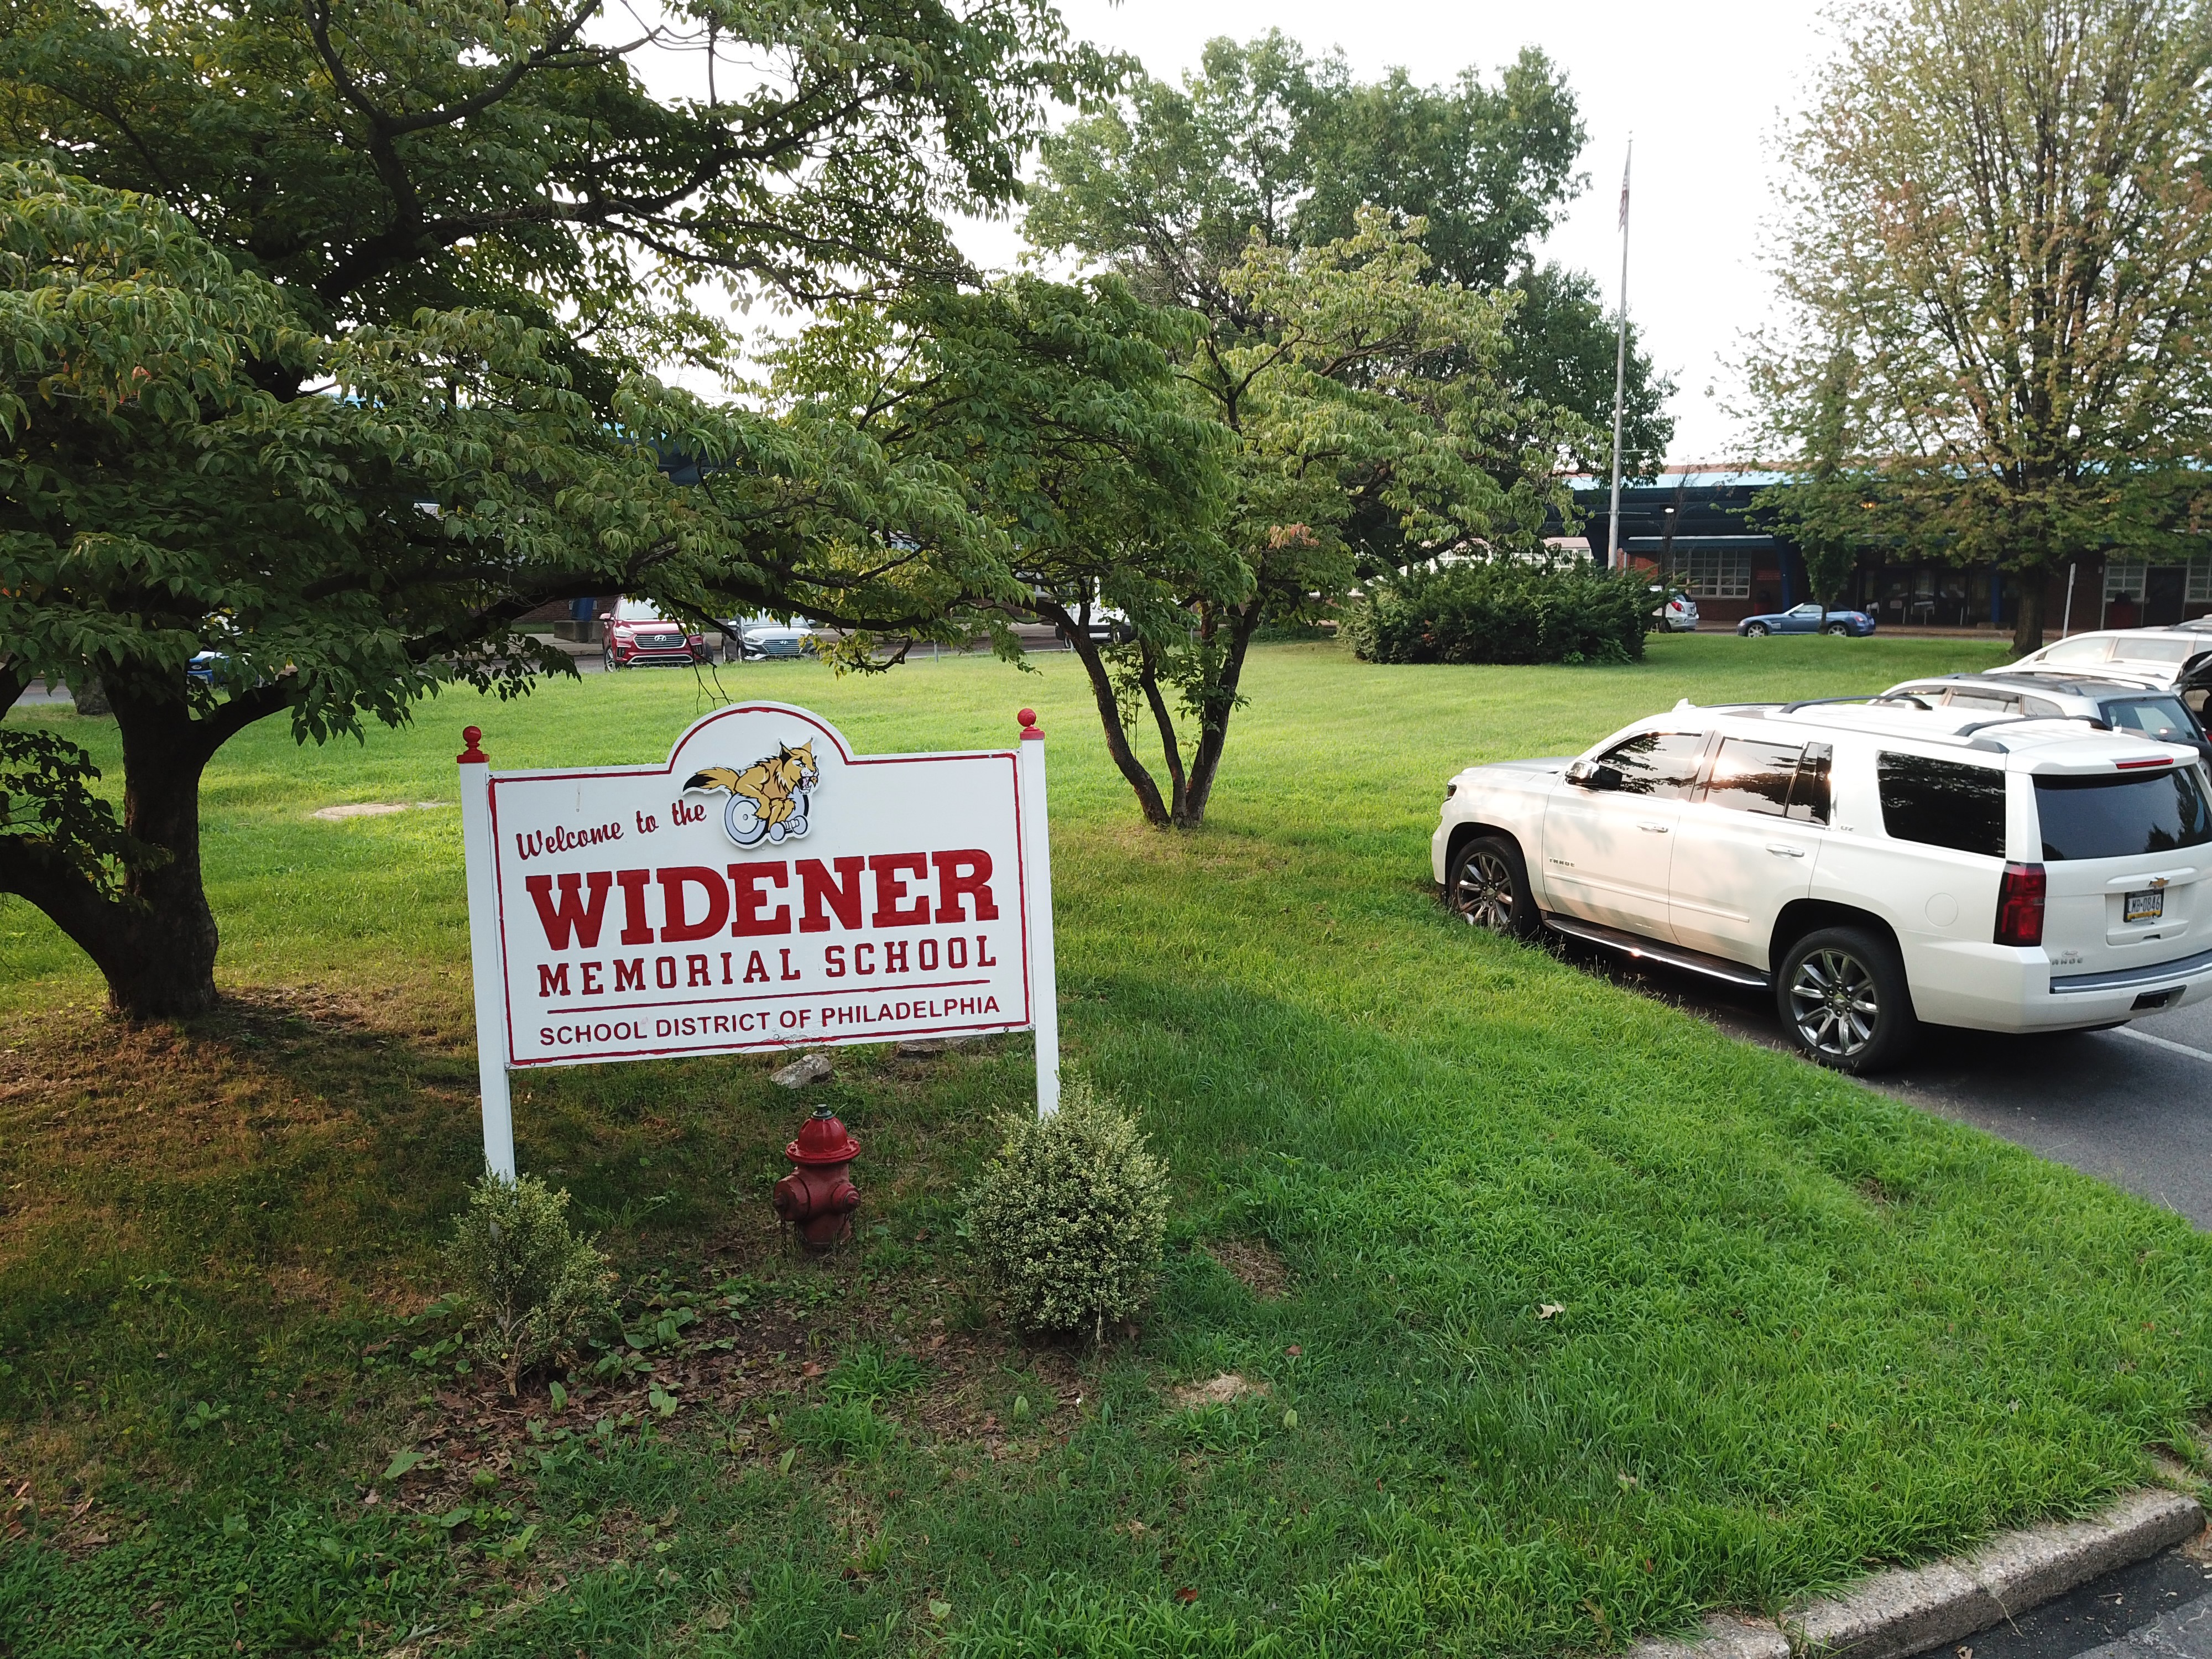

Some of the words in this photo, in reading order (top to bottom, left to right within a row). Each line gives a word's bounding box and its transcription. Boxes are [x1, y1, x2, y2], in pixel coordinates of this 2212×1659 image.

[517, 822, 624, 860] Welcome
[637, 811, 659, 834] to
[672, 800, 707, 826] the
[526, 849, 999, 951] WIDENER
[538, 948, 801, 997] MEMORIAL
[825, 935, 997, 977] SCHOOL
[540, 1021, 647, 1046] SCHOOL
[656, 1011, 771, 1037] DISTRICT
[780, 1009, 811, 1029] OF
[822, 996, 1000, 1027] PHILADELPHIA
